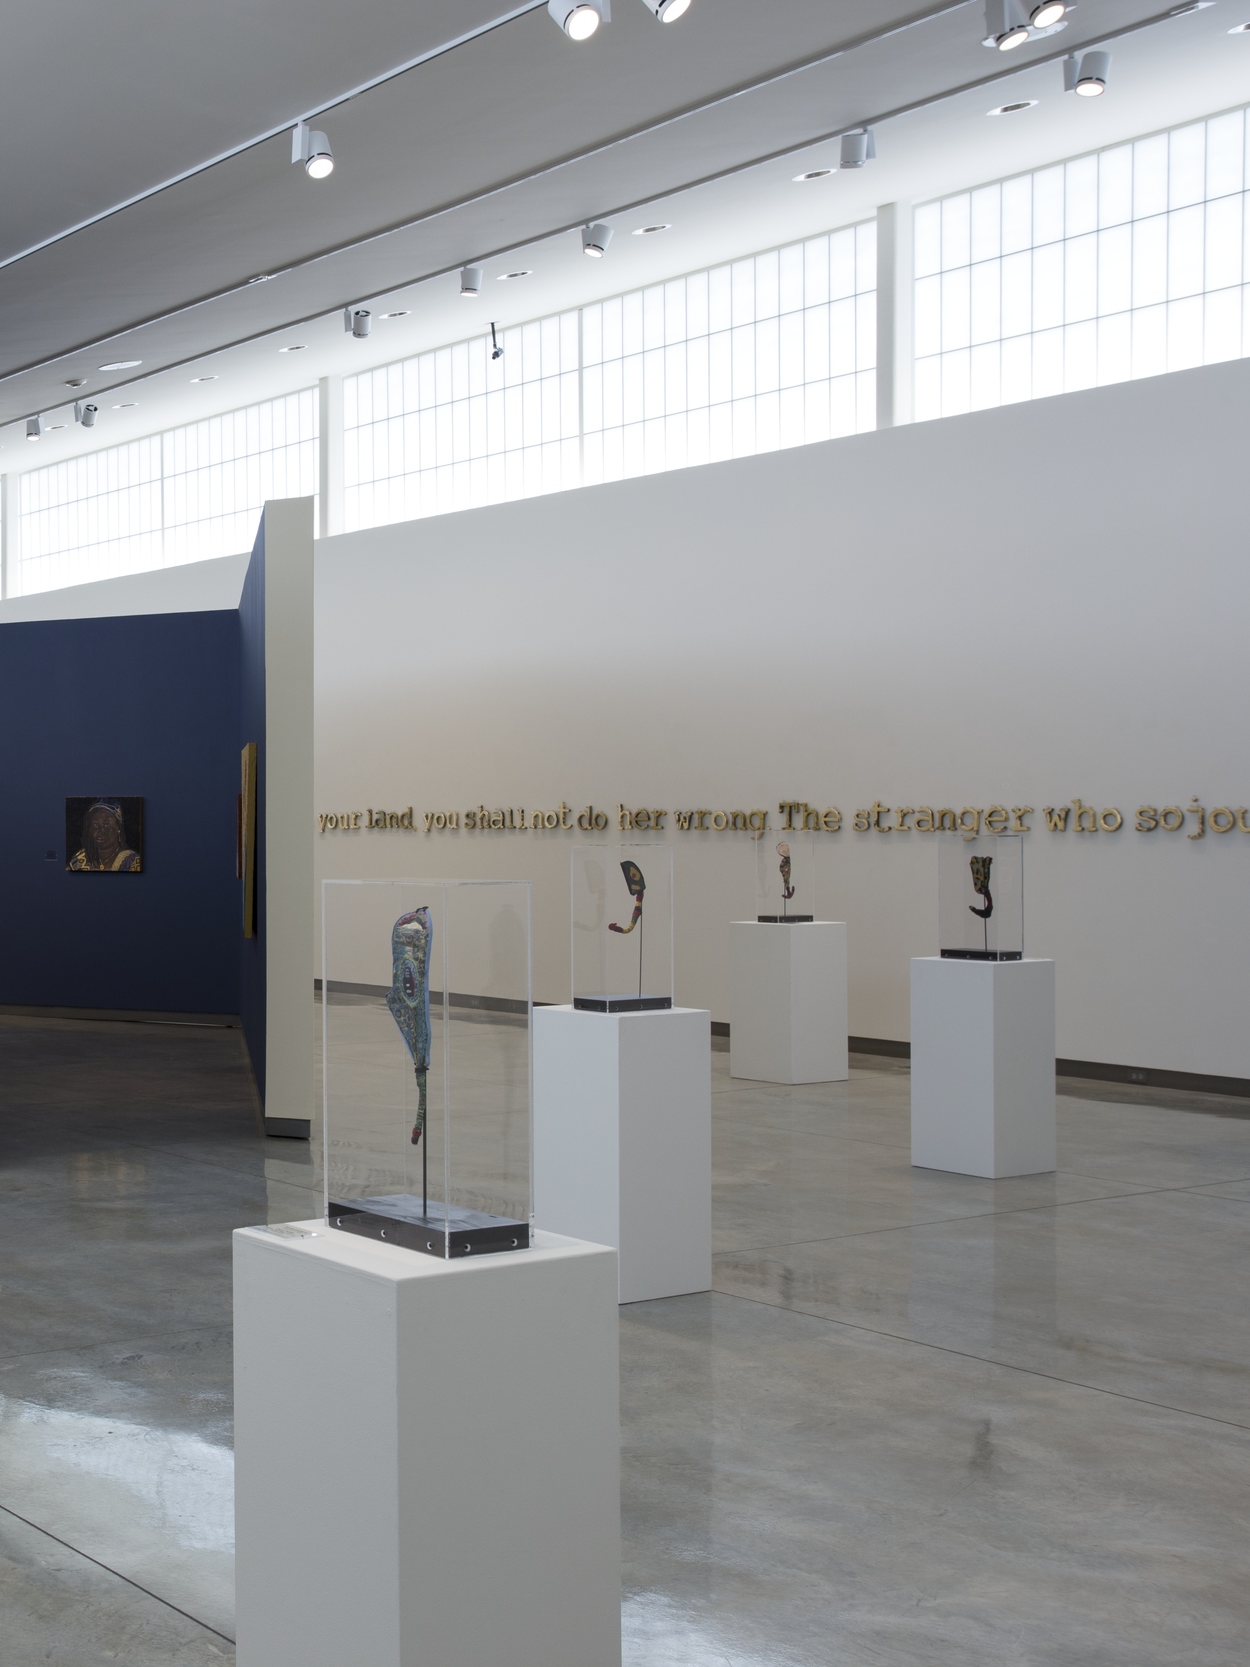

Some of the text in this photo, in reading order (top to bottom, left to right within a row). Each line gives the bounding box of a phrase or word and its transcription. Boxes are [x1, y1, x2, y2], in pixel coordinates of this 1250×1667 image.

[318, 811, 362, 833] your
[423, 811, 459, 833] you
[577, 804, 609, 831] do
[617, 803, 667, 831] her
[674, 808, 771, 840] wrong.
[778, 801, 842, 832] The
[853, 800, 1034, 841] stranger
[1043, 799, 1123, 832] who
